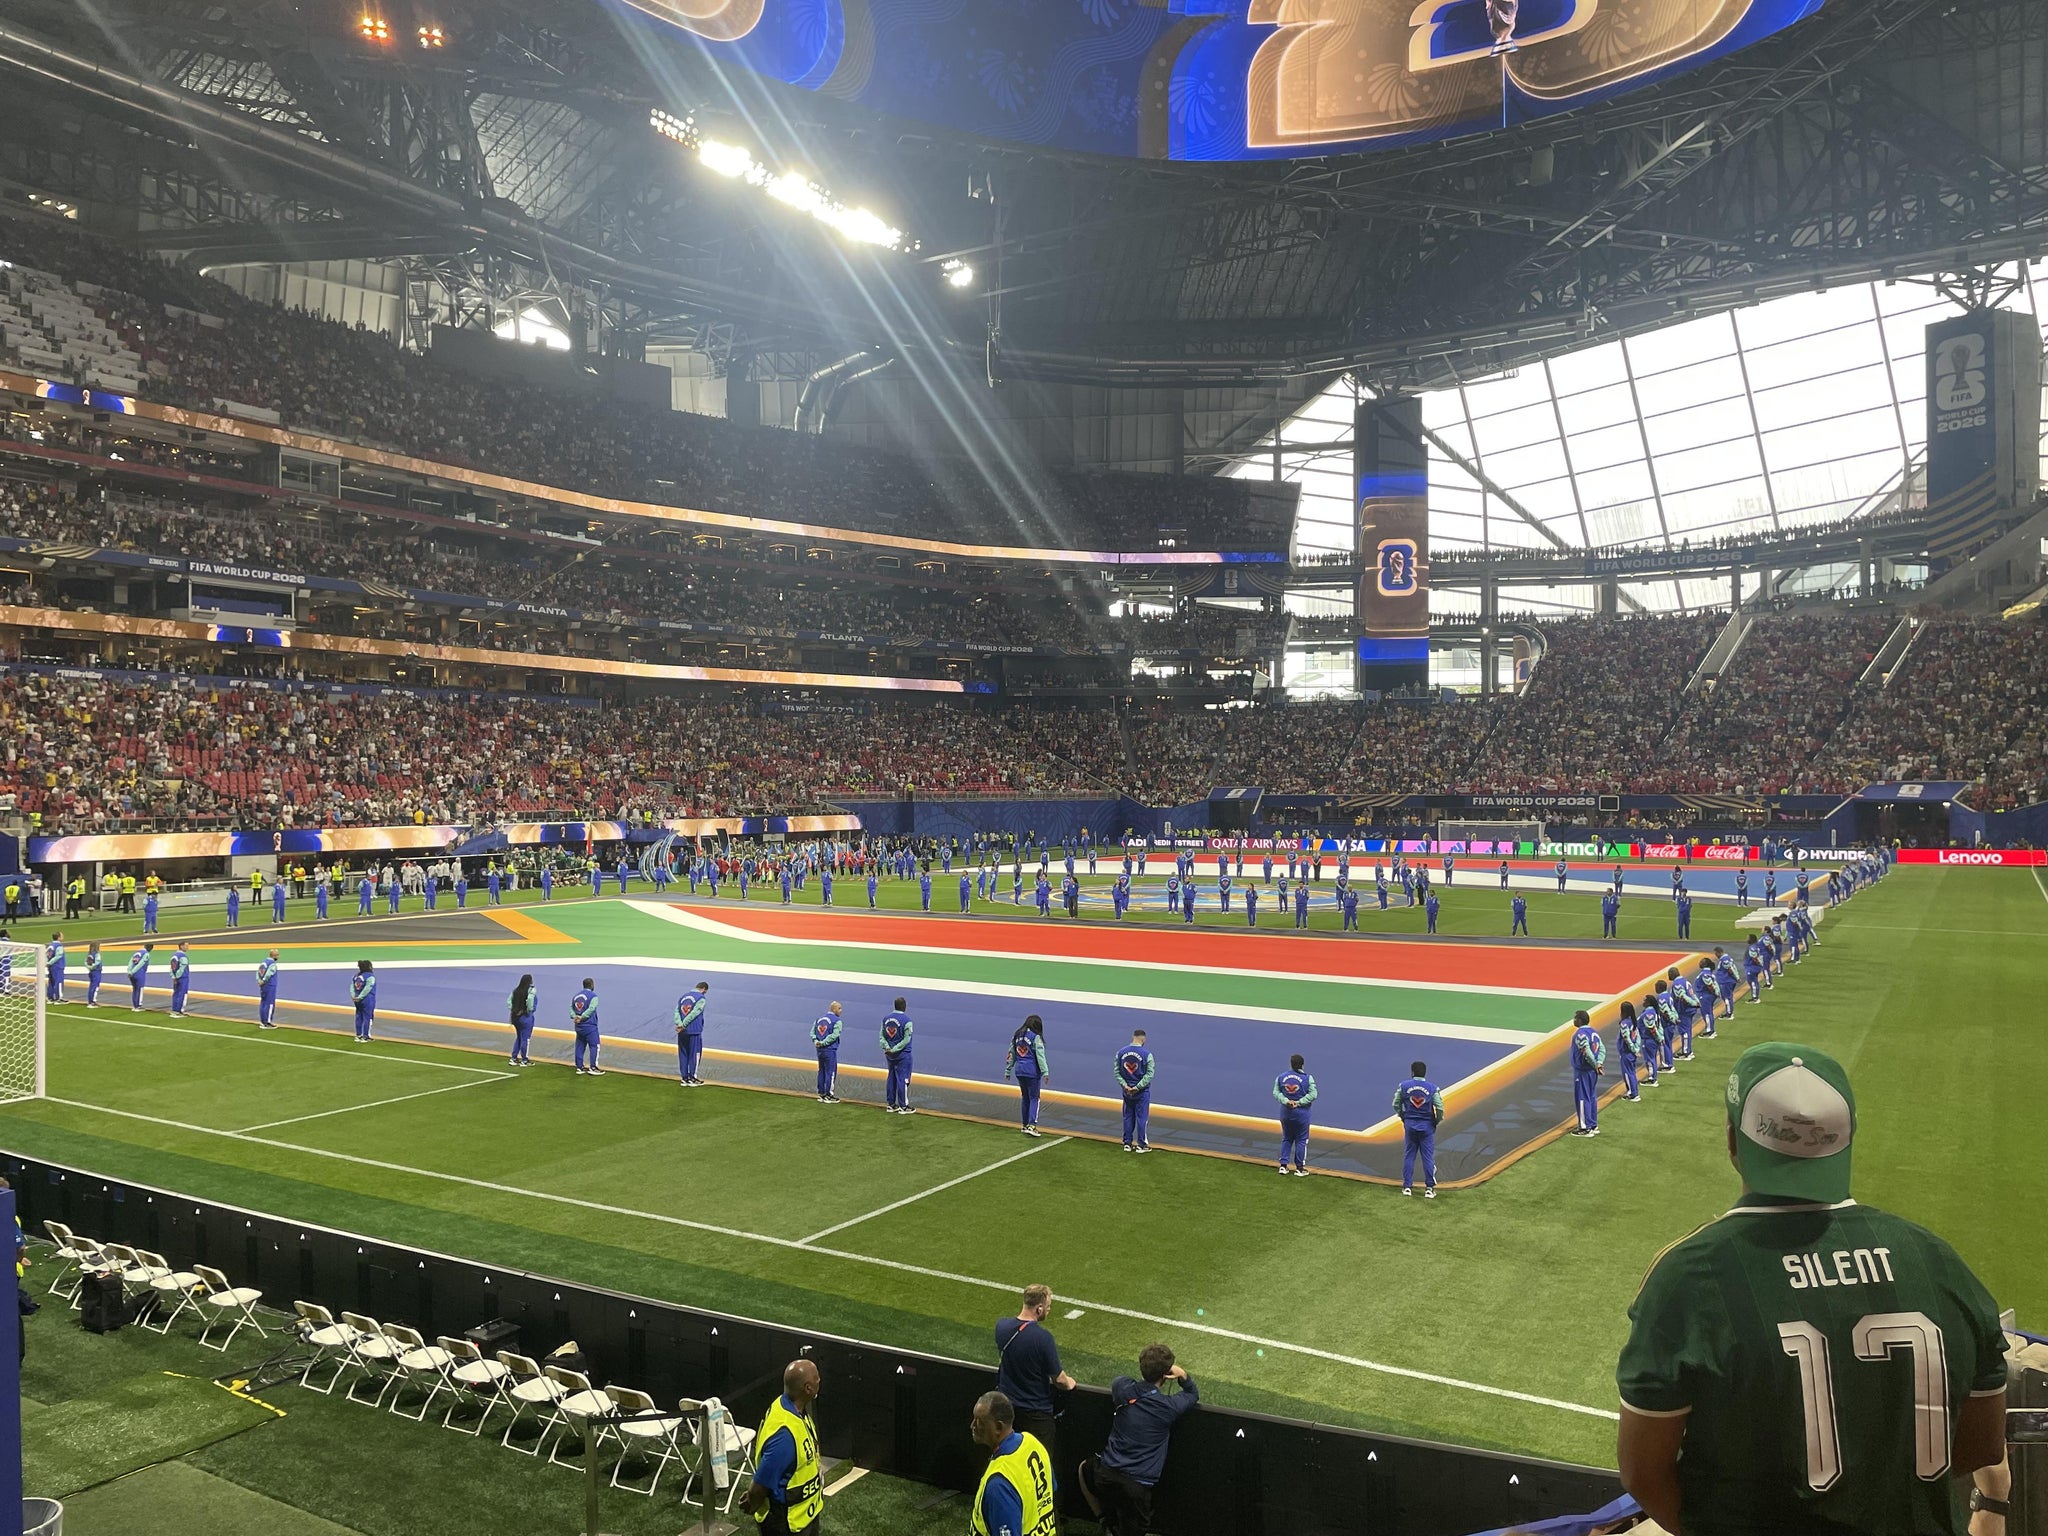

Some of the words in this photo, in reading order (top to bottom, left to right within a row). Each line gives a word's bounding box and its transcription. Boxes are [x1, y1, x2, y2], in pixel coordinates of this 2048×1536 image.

[1951, 392, 1972, 403] FIFA
[1937, 410, 1968, 421] WORLD
[1968, 406, 1986, 415] CUP
[1937, 415, 1987, 433] 2026
[1593, 561, 1621, 572] FIFA
[1621, 557, 1667, 570] WORLD
[1668, 555, 1695, 566] CUP
[1696, 551, 1743, 563] 2026
[190, 562, 212, 573] FIFA
[214, 565, 250, 577] WORLD
[252, 569, 271, 579] CUP
[272, 573, 306, 584] 2026
[517, 603, 568, 617] ATLANTA
[819, 633, 865, 643] ATLANTA
[1473, 797, 1495, 806] FIFA
[1495, 797, 1534, 806] WORLD
[1534, 797, 1557, 806] CUP
[1557, 797, 1596, 806] 2026
[1301, 829, 1320, 838] FIA
[1724, 834, 1750, 844] FIFA
[1127, 838, 1147, 847] ADI
[1153, 839, 1204, 847] REDITSTREET
[1211, 838, 1249, 849] QATAR
[1252, 838, 1298, 849] AIRWAYS
[1335, 840, 1367, 852] VSA
[1810, 849, 1867, 861] HYUNDA
[1938, 851, 2003, 864] Lenovo
[1782, 1247, 1896, 1289] SILENT
[1777, 1310, 1951, 1492] 17
[803, 1476, 820, 1499] SEC
